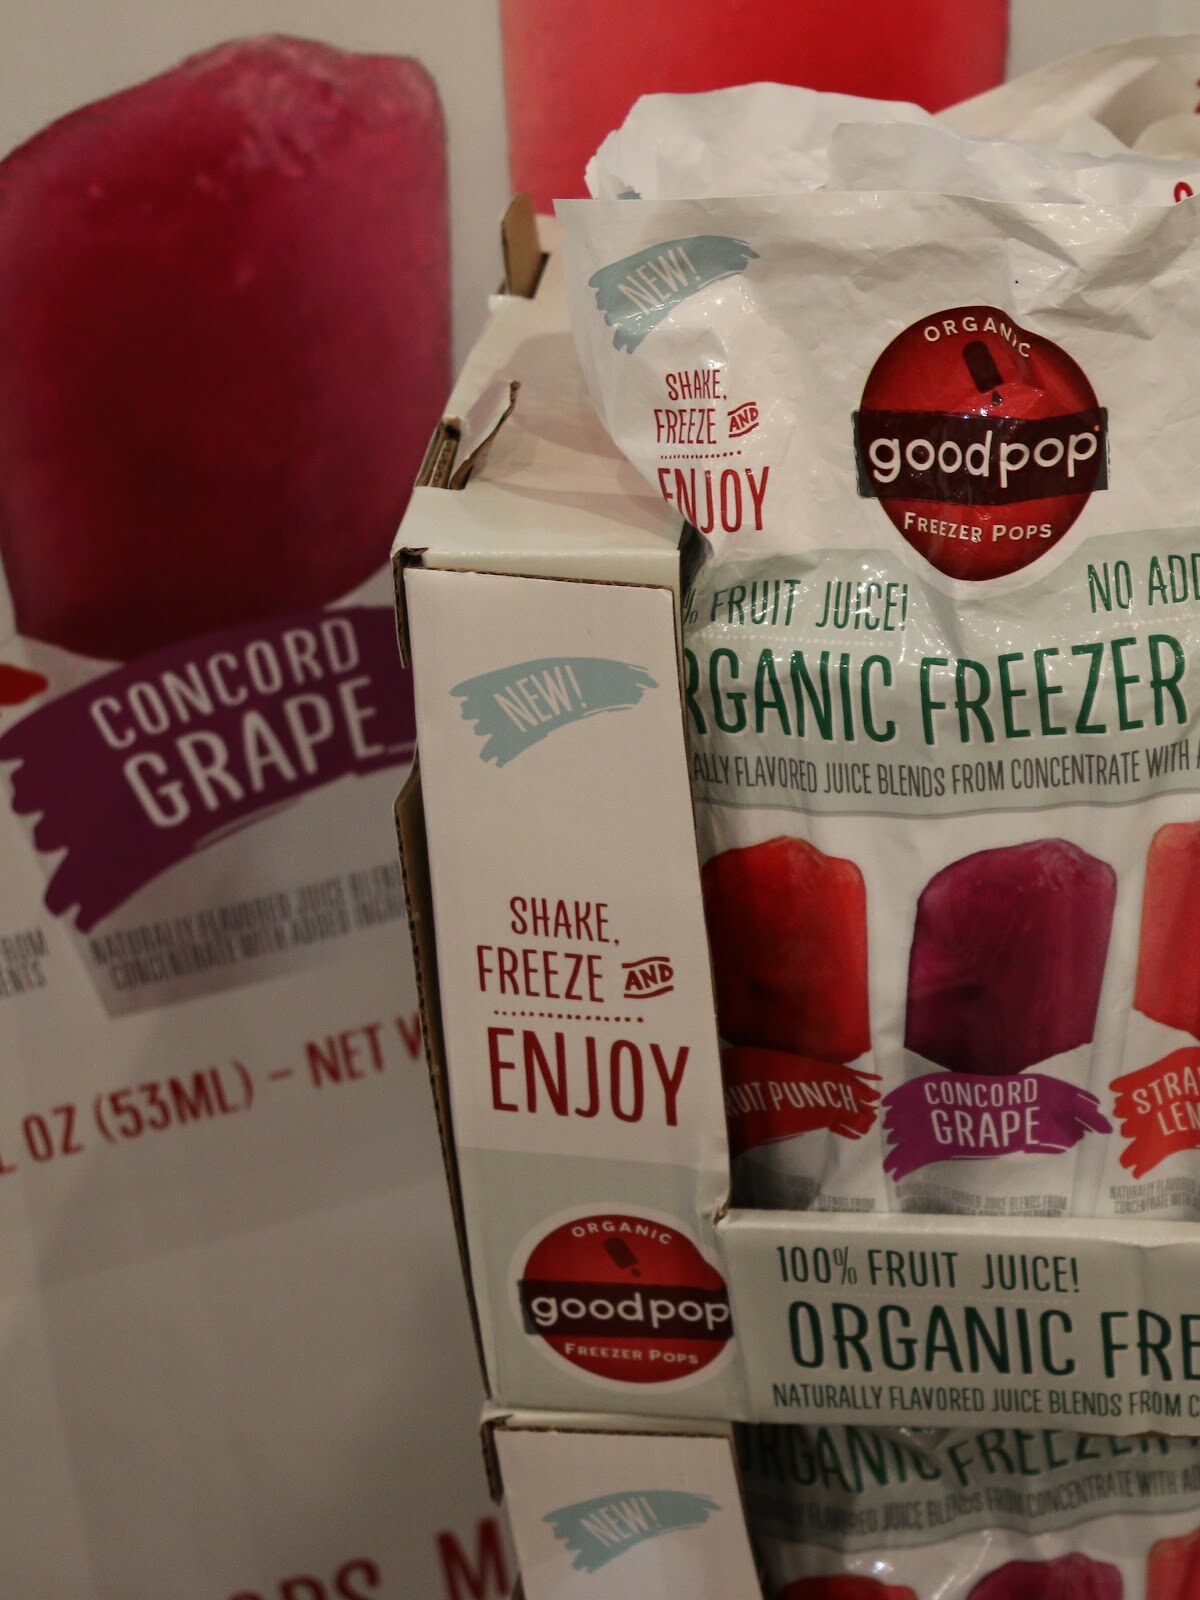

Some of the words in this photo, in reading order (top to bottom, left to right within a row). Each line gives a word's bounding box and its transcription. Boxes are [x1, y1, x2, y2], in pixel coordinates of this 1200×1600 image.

[618, 246, 700, 312] NEW!
[923, 317, 1031, 358] ORGANIC
[665, 369, 727, 401] SHAKE,
[654, 408, 717, 444] FREEZE
[728, 406, 759, 432] AND
[869, 430, 1098, 488] goodpop
[658, 466, 770, 534] ENJOY
[904, 511, 983, 543] FREEZER
[992, 523, 1052, 541] POPS
[710, 579, 801, 626] FRUIT
[815, 581, 909, 632] JUICE!
[1087, 560, 1134, 614] NO
[89, 617, 361, 750] CONCORD
[494, 664, 587, 734] NEW!
[682, 647, 896, 743] RGANIC
[920, 634, 1187, 745] FREEZER
[123, 676, 385, 829] GRAPE
[735, 756, 818, 793] FLAVORED
[824, 762, 872, 795] JUICE
[878, 763, 946, 798] BLENDS
[952, 760, 1005, 796] FROM
[1011, 750, 1140, 791] CONCENTRATE
[1146, 739, 1190, 779] WITH
[509, 896, 620, 946] SHAKE,
[476, 945, 605, 1003] FREEZE
[624, 963, 674, 992] AND
[21, 1104, 85, 1164] OZ
[93, 1058, 254, 1144] (53ML)
[305, 1022, 385, 1089] NET
[487, 1026, 690, 1127] ENJOY
[768, 1080, 859, 1113] PUNCH
[924, 1076, 1040, 1108] CONCORD
[930, 1107, 1043, 1148] GRAPE
[572, 1220, 673, 1245] ORGANIC
[777, 1246, 858, 1285] 100%
[867, 1249, 958, 1288] FRUIT
[981, 1253, 1080, 1294] JUICE!
[530, 1292, 730, 1331] goodpop
[564, 1342, 643, 1361] FREEZER
[649, 1349, 699, 1365] POPS
[788, 1300, 1076, 1376] ORGANIC
[772, 1383, 883, 1410] NATURALLY
[889, 1386, 985, 1413] FLAVORED
[991, 1388, 1043, 1414] JUICE
[1049, 1390, 1123, 1417] BLENDS
[1129, 1391, 1182, 1418] FROM
[580, 1497, 663, 1549] NEW!
